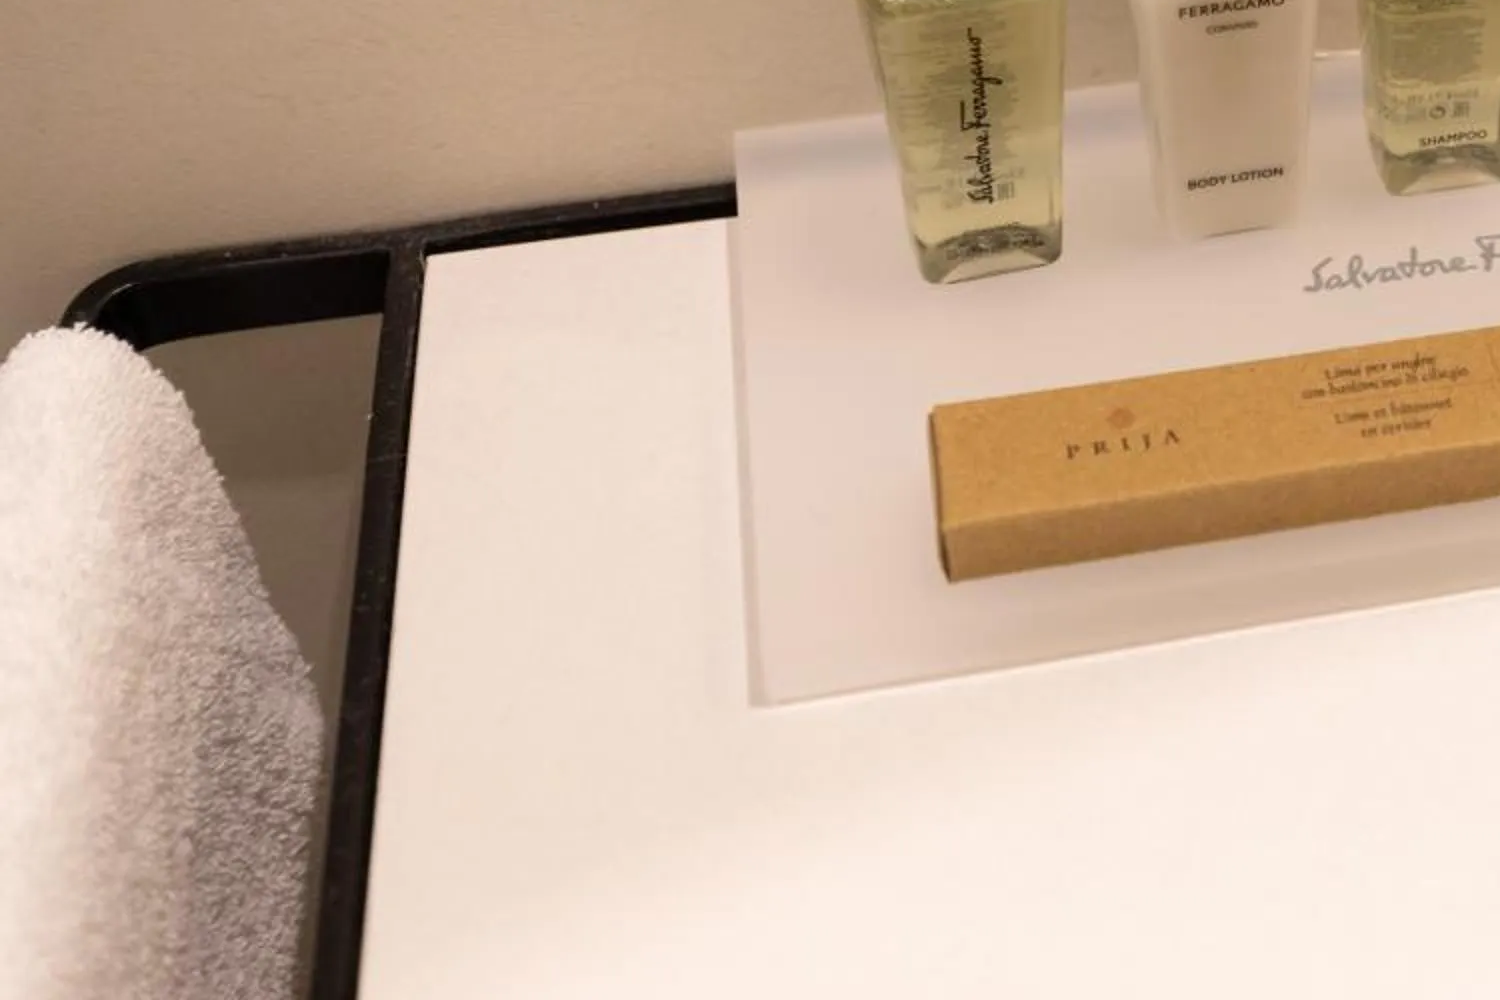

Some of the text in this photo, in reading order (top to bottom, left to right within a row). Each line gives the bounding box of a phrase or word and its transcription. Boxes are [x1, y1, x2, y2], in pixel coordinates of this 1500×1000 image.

[959, 28, 1004, 204] Salvatore Ferragamo
[1418, 129, 1488, 148] SHAMPOO
[1186, 167, 1284, 191] BODY LOTION
[1303, 246, 1477, 293] Salvatore
[1066, 429, 1181, 460] PRIJA
